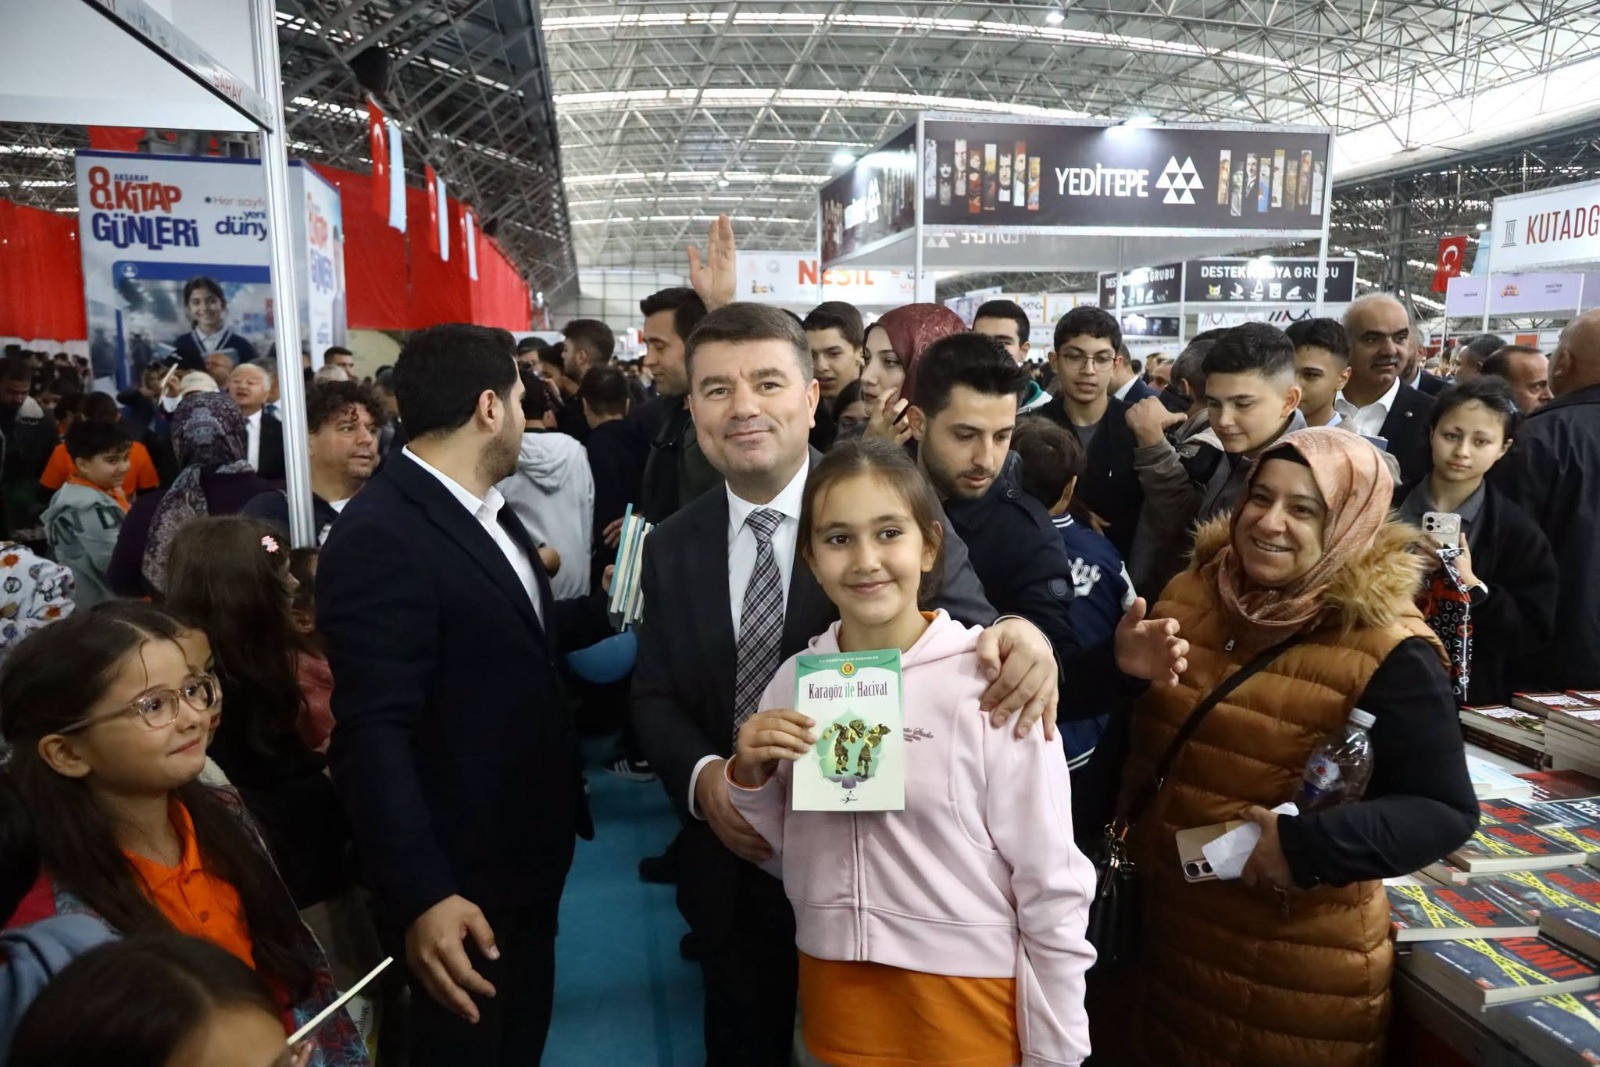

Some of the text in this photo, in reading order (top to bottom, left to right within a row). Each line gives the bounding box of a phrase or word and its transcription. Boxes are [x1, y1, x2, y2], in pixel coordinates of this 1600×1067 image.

[1055, 162, 1149, 197] YEDİTEPE
[1201, 264, 1246, 278] DESTEK
[808, 681, 888, 701] Karagöz ile Hacivat
